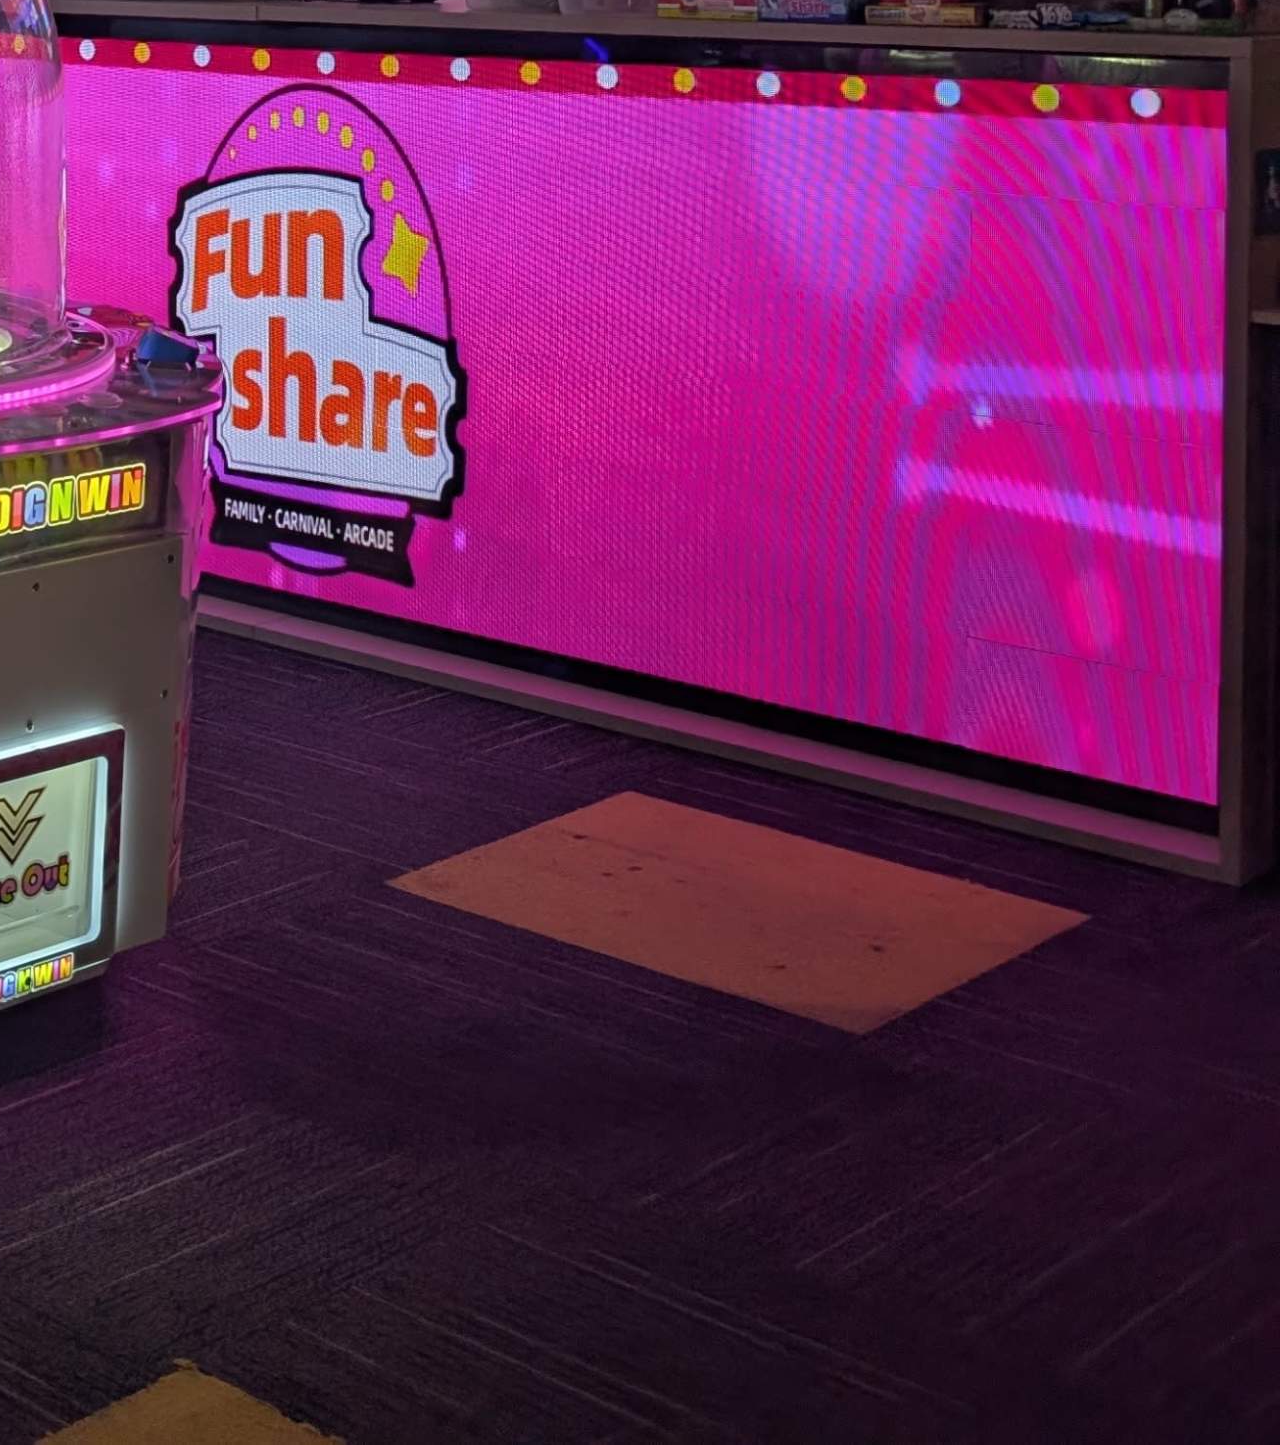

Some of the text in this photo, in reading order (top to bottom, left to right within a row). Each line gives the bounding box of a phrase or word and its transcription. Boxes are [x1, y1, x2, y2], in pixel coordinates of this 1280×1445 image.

[191, 208, 345, 314] Fun
[231, 316, 437, 457] share
[224, 498, 394, 552] FAMILY CARNIVAL ARCADE
[22, 854, 70, 897] Out
